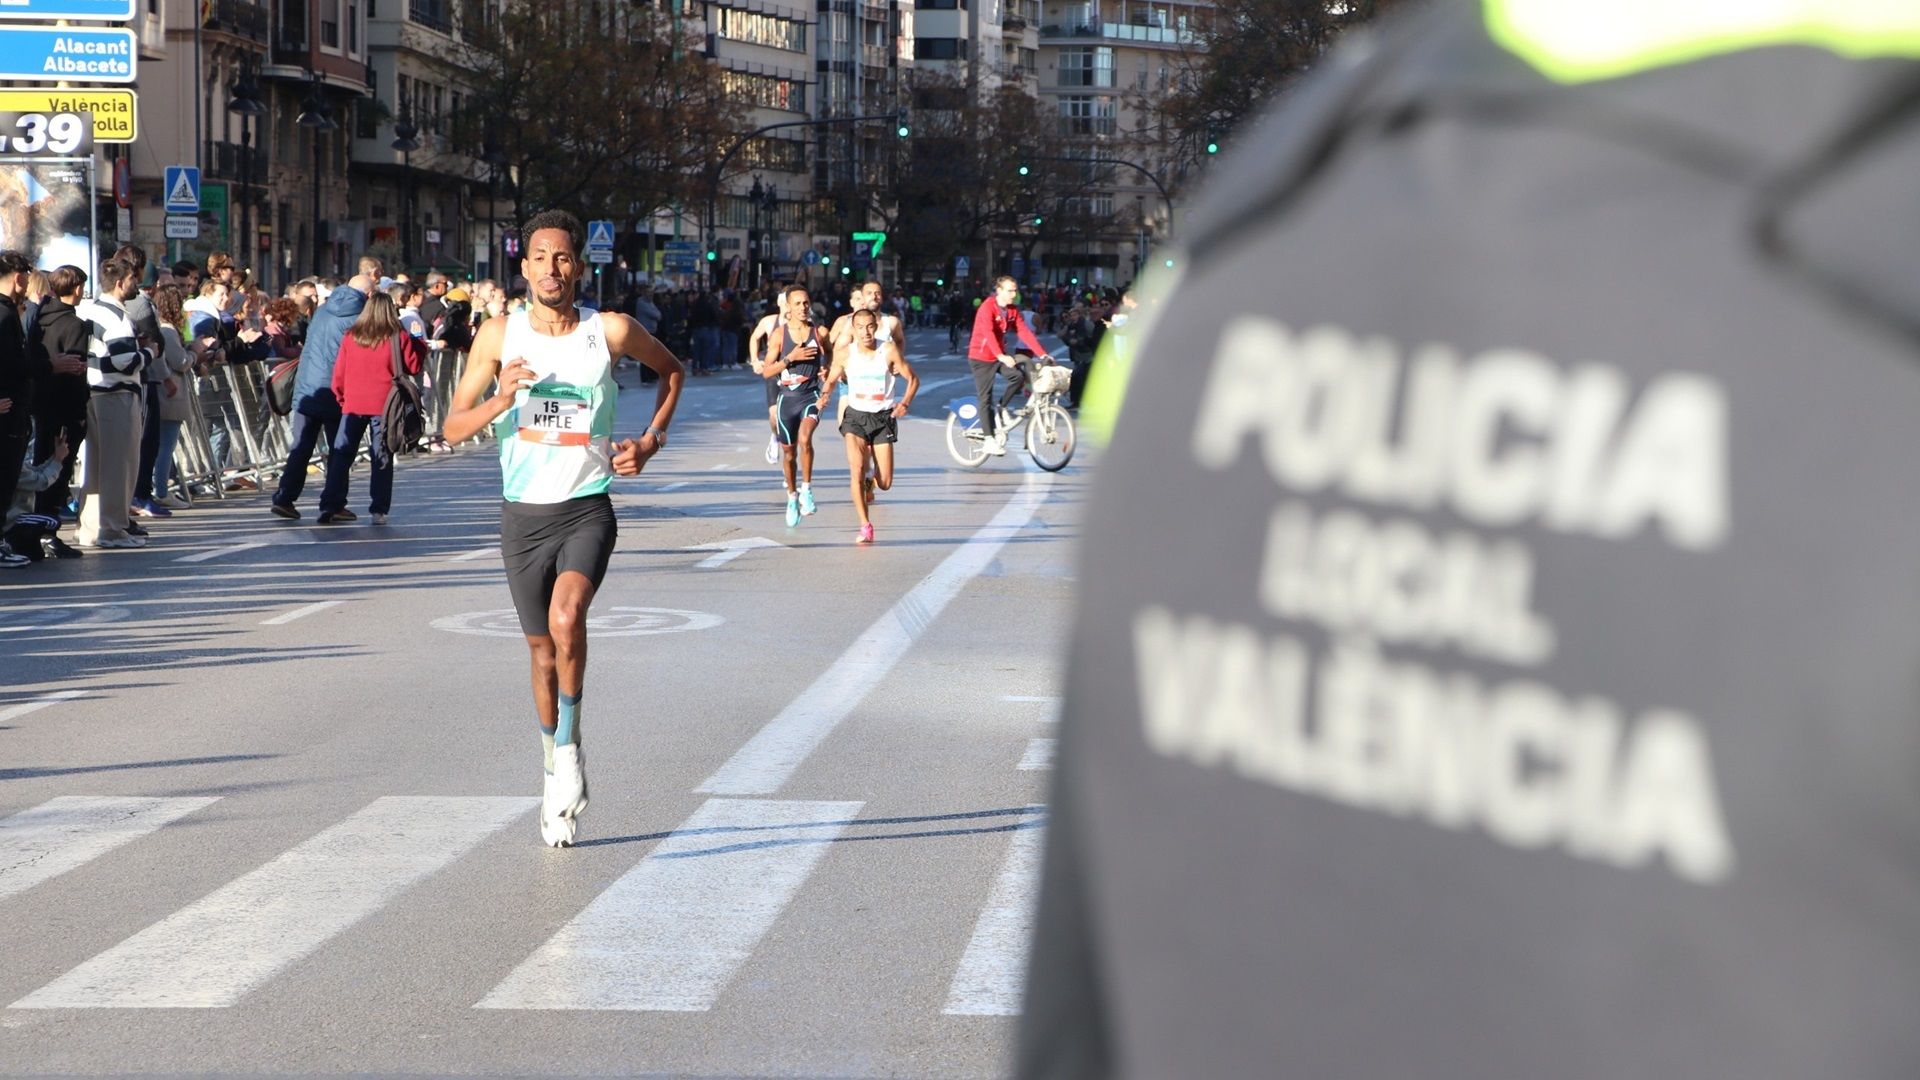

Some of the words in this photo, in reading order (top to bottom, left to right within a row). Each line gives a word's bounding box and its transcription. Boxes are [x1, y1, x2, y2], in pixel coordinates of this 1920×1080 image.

[53, 37, 128, 55] Alacant
[43, 56, 128, 74] Albacete
[49, 98, 128, 112] València
[856, 242, 868, 255] P
[543, 401, 559, 413] 15
[534, 414, 572, 429] KIFLE
[1260, 505, 1555, 666] LOCAL
